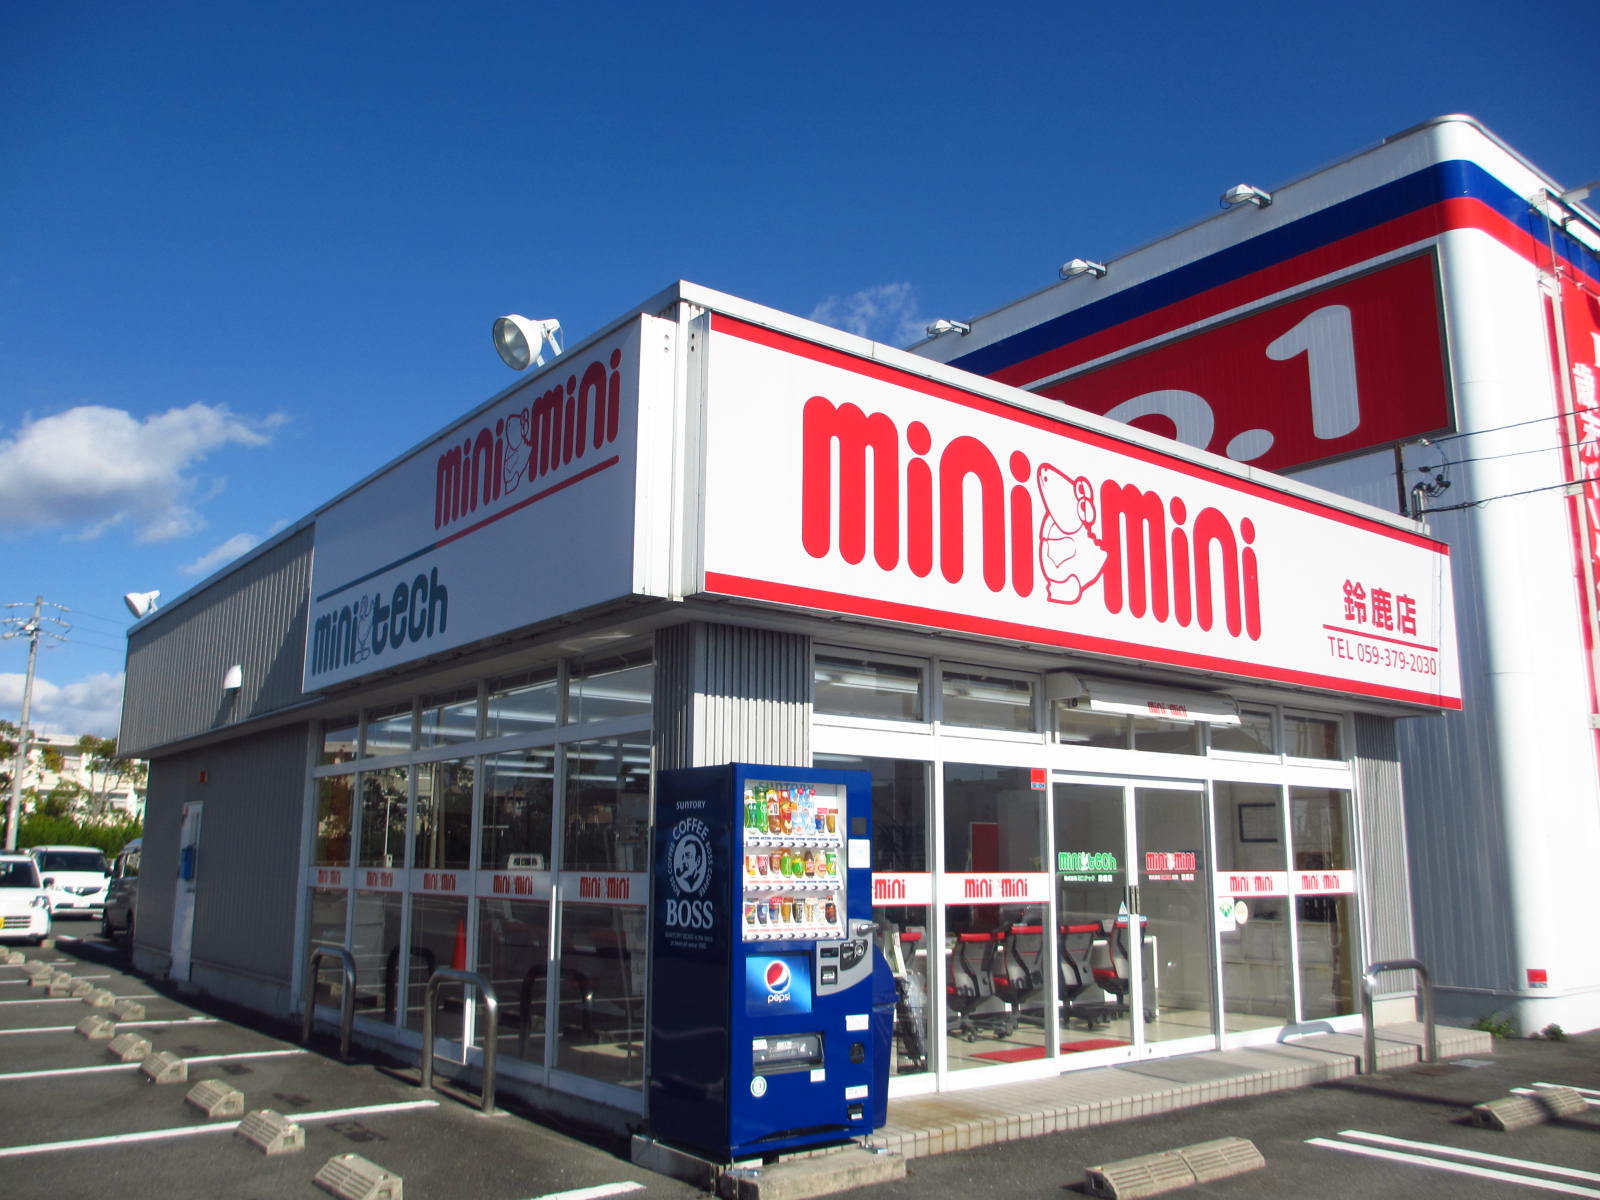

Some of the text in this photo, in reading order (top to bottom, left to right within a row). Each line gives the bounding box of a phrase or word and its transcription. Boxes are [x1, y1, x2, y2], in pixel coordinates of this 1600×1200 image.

[435, 348, 622, 531] mini mini
[802, 396, 1262, 641] mini mini
[1343, 579, 1416, 636] 鈴鹿店
[312, 601, 361, 676] mini
[1328, 636, 1437, 676] TEL 059-379-2030
[676, 801, 706, 810] SUNTORY
[673, 817, 709, 841] COFFEE
[580, 877, 629, 899] mini mini
[875, 879, 906, 899] mini
[965, 878, 1028, 898] mini mini
[1230, 876, 1273, 892] mini mini
[1302, 874, 1339, 890] mini mini
[665, 899, 714, 929] BOSS
[767, 992, 791, 1004] pepsi
